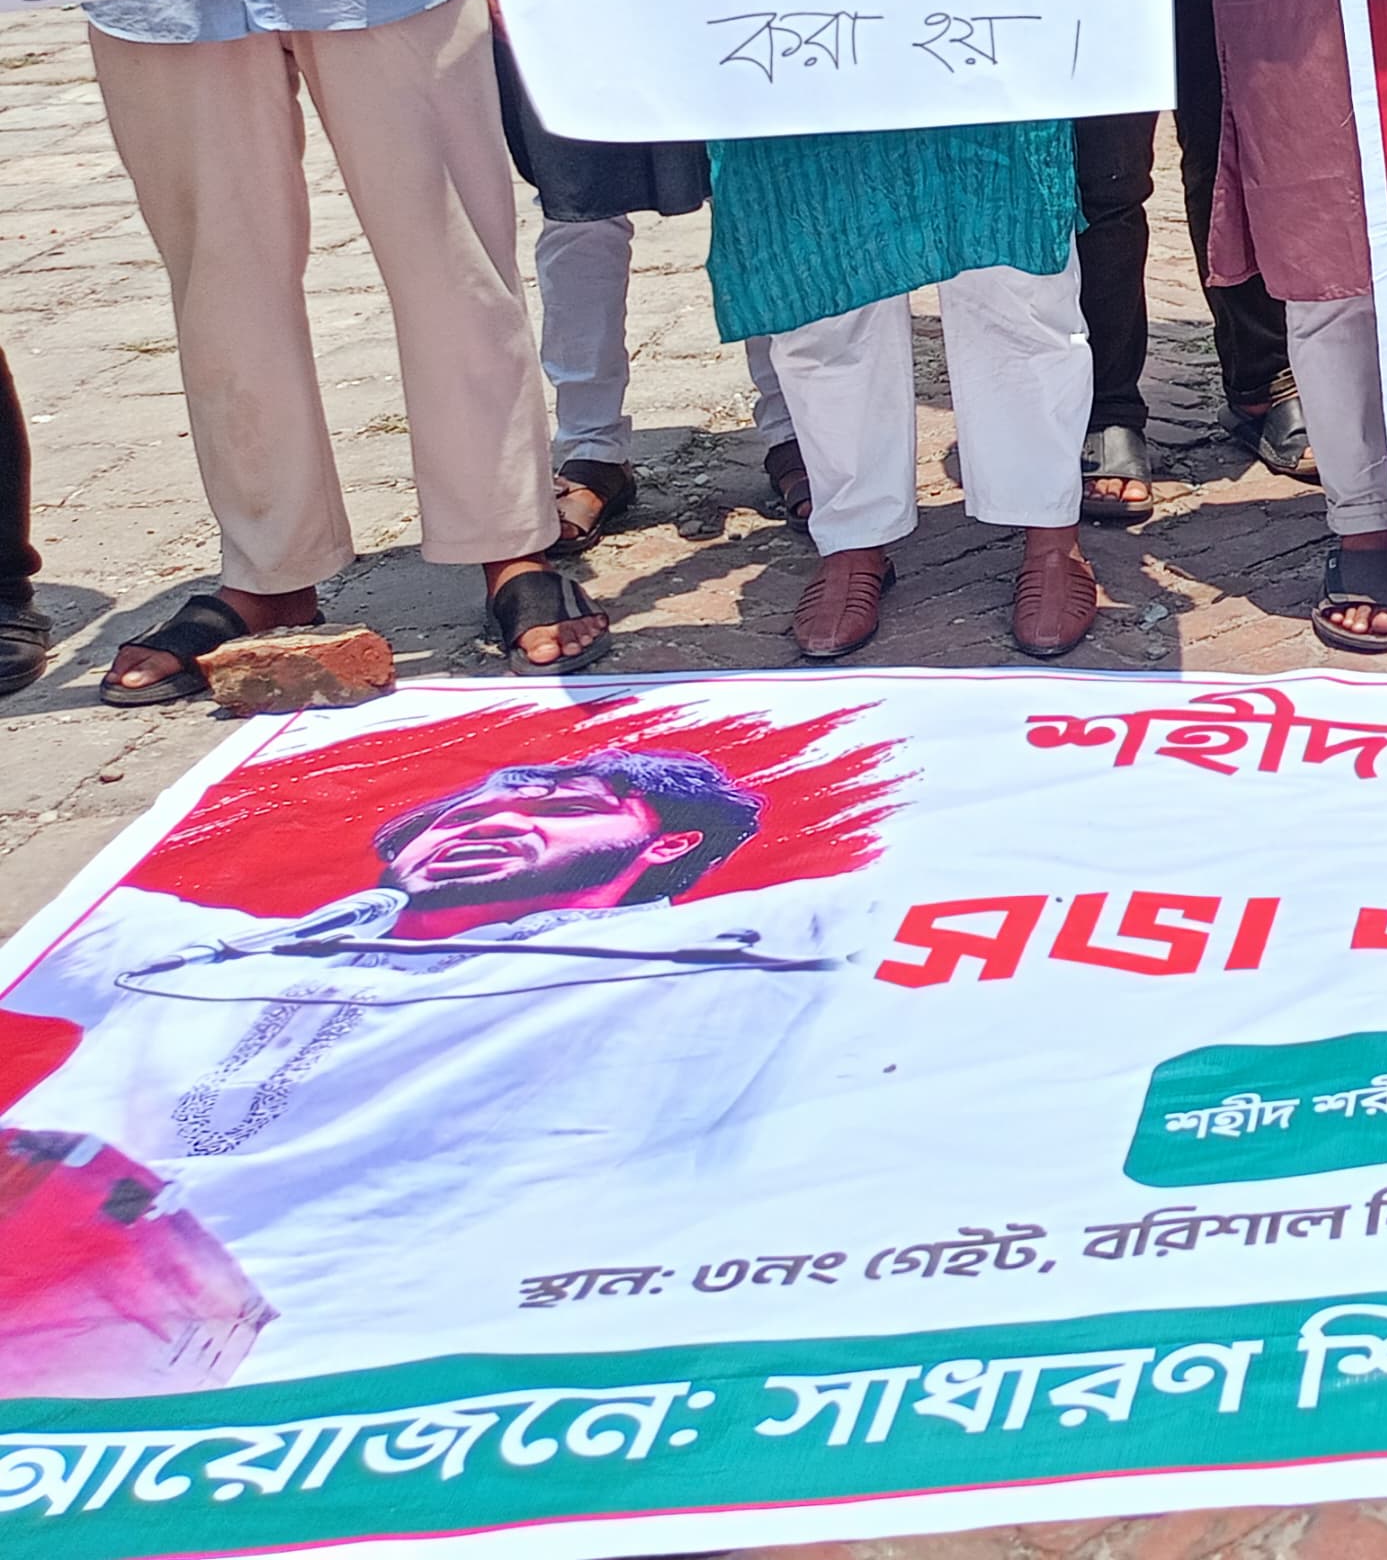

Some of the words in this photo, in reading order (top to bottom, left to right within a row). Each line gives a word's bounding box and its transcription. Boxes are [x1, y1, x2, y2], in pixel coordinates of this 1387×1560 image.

[708, 11, 884, 83] করা
[874, 891, 1281, 989] সভা
[1165, 1095, 1295, 1140] শহীদ
[517, 1262, 674, 1309] স্থান:
[691, 1250, 847, 1294] ৩নং
[863, 1224, 1056, 1281] গেইট,
[1082, 1204, 1350, 1262] বরিশাল
[754, 1336, 1262, 1448] সাধারণ
